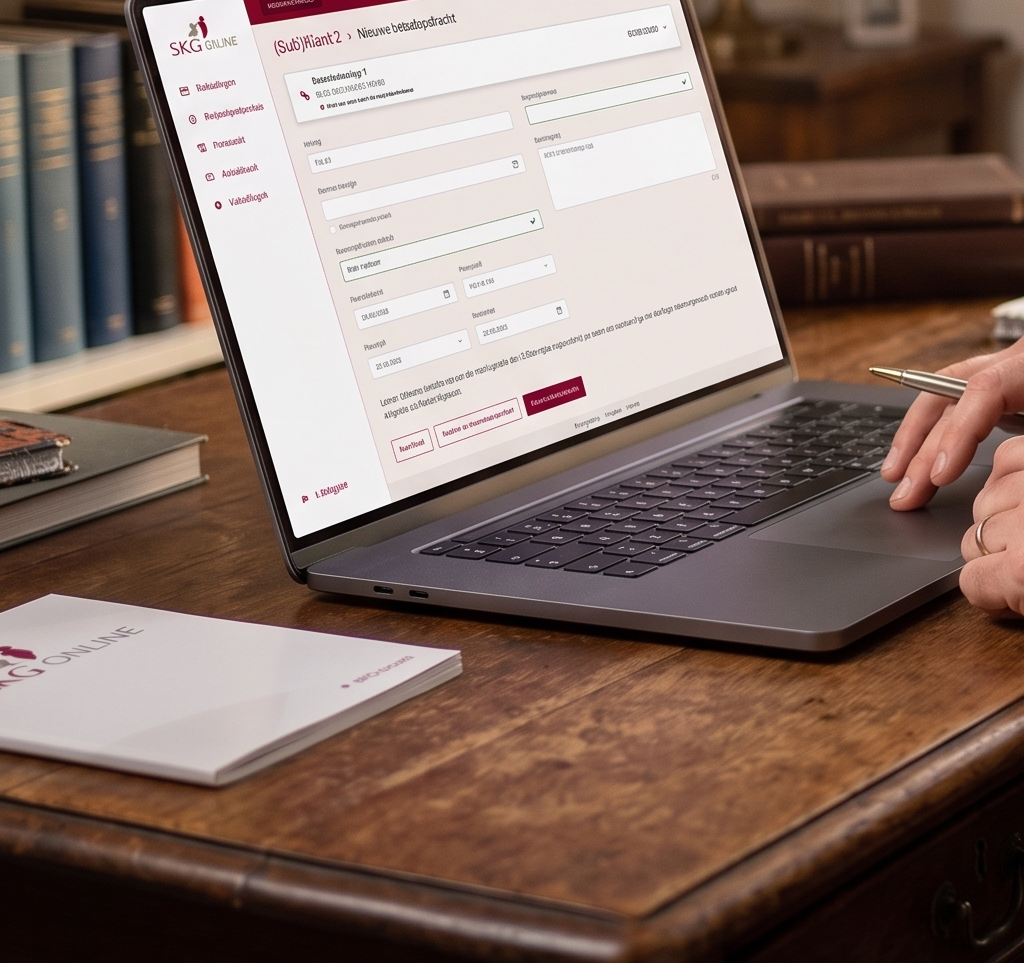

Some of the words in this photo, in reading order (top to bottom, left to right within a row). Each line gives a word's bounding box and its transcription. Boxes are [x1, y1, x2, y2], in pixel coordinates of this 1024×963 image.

[335, 30, 342, 44] 2
[357, 24, 391, 39] Nieuwe
[170, 39, 203, 56] SKG
[42, 626, 144, 665] ONLINE
